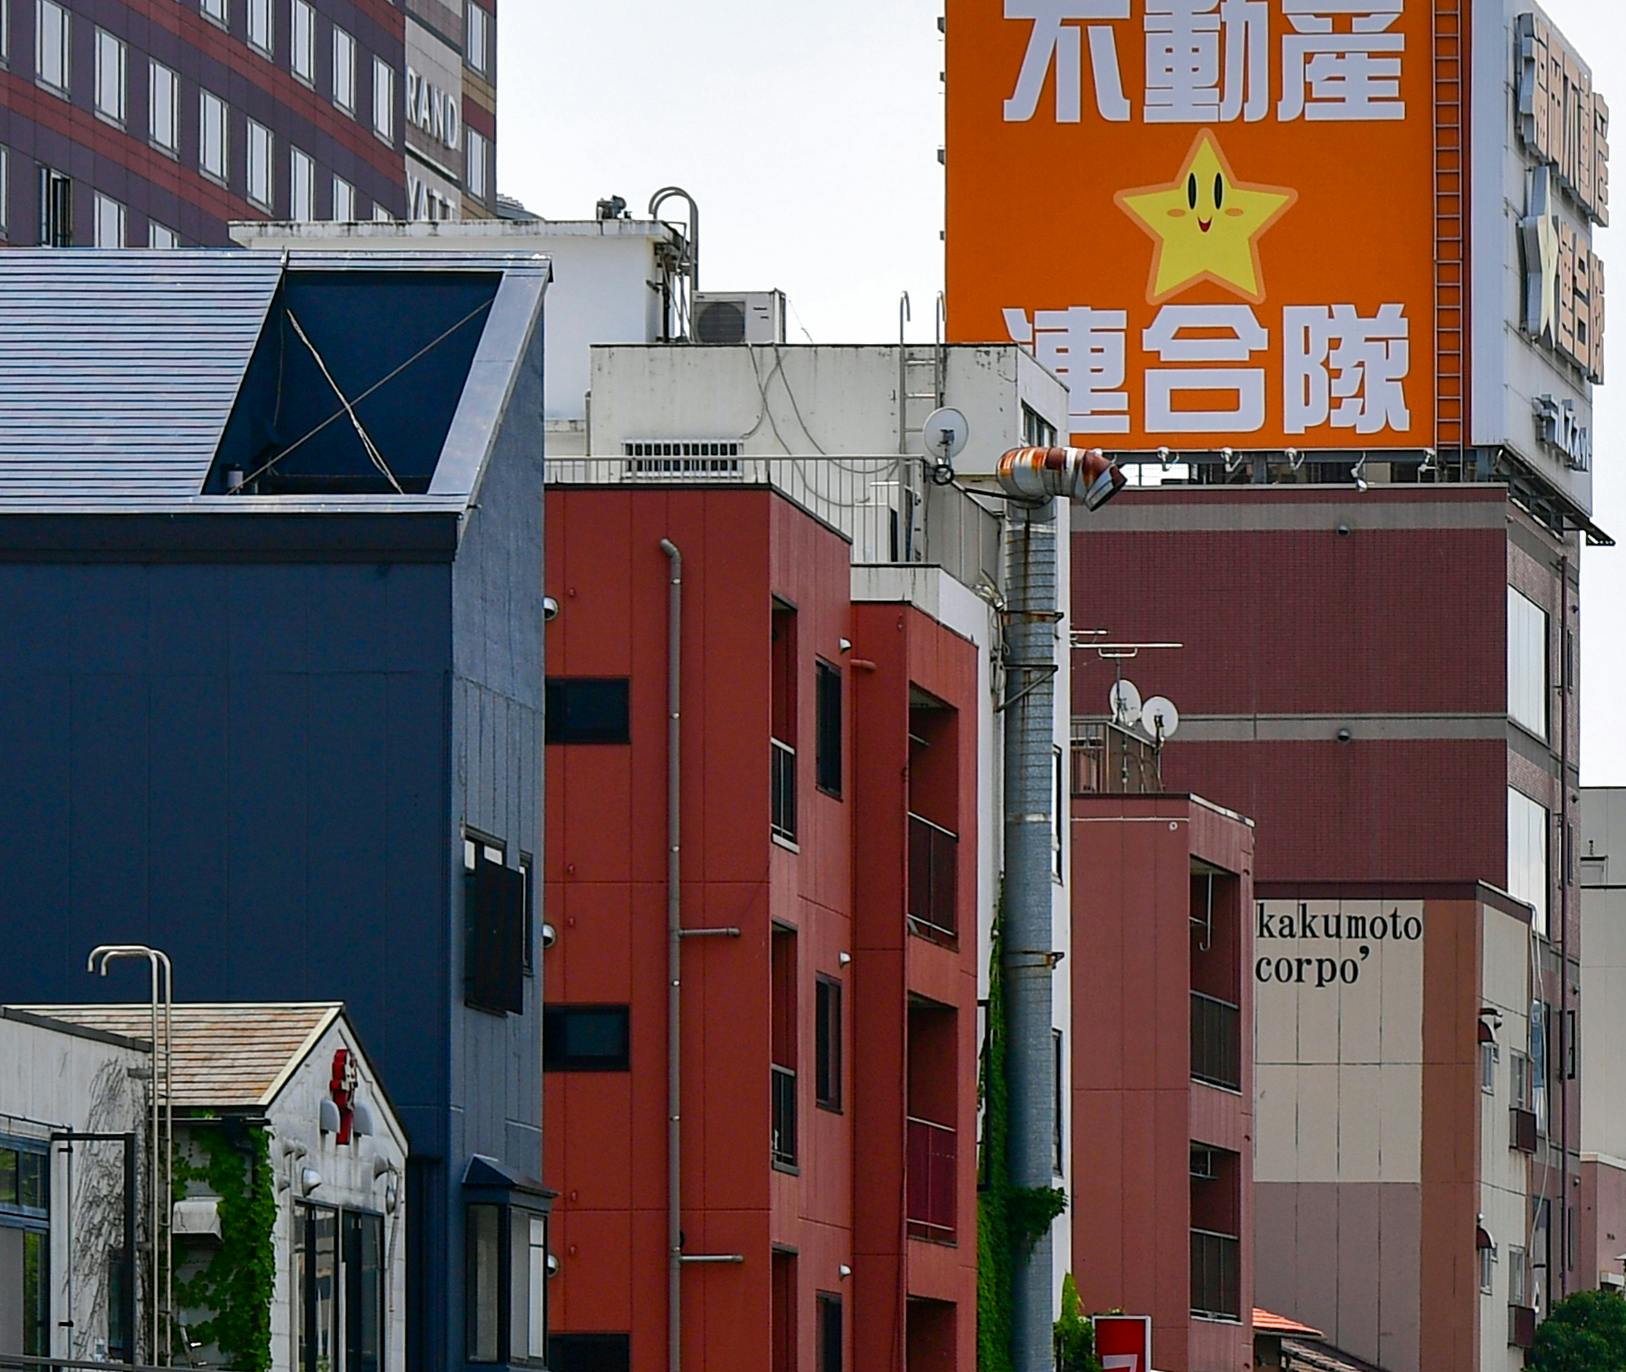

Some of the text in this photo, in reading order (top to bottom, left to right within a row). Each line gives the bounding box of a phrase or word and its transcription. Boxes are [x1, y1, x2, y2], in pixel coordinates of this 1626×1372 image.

[1003, 0, 1405, 123] 不動産
[1002, 304, 1409, 434] 連合隊
[1256, 903, 1422, 940] kakumoto
